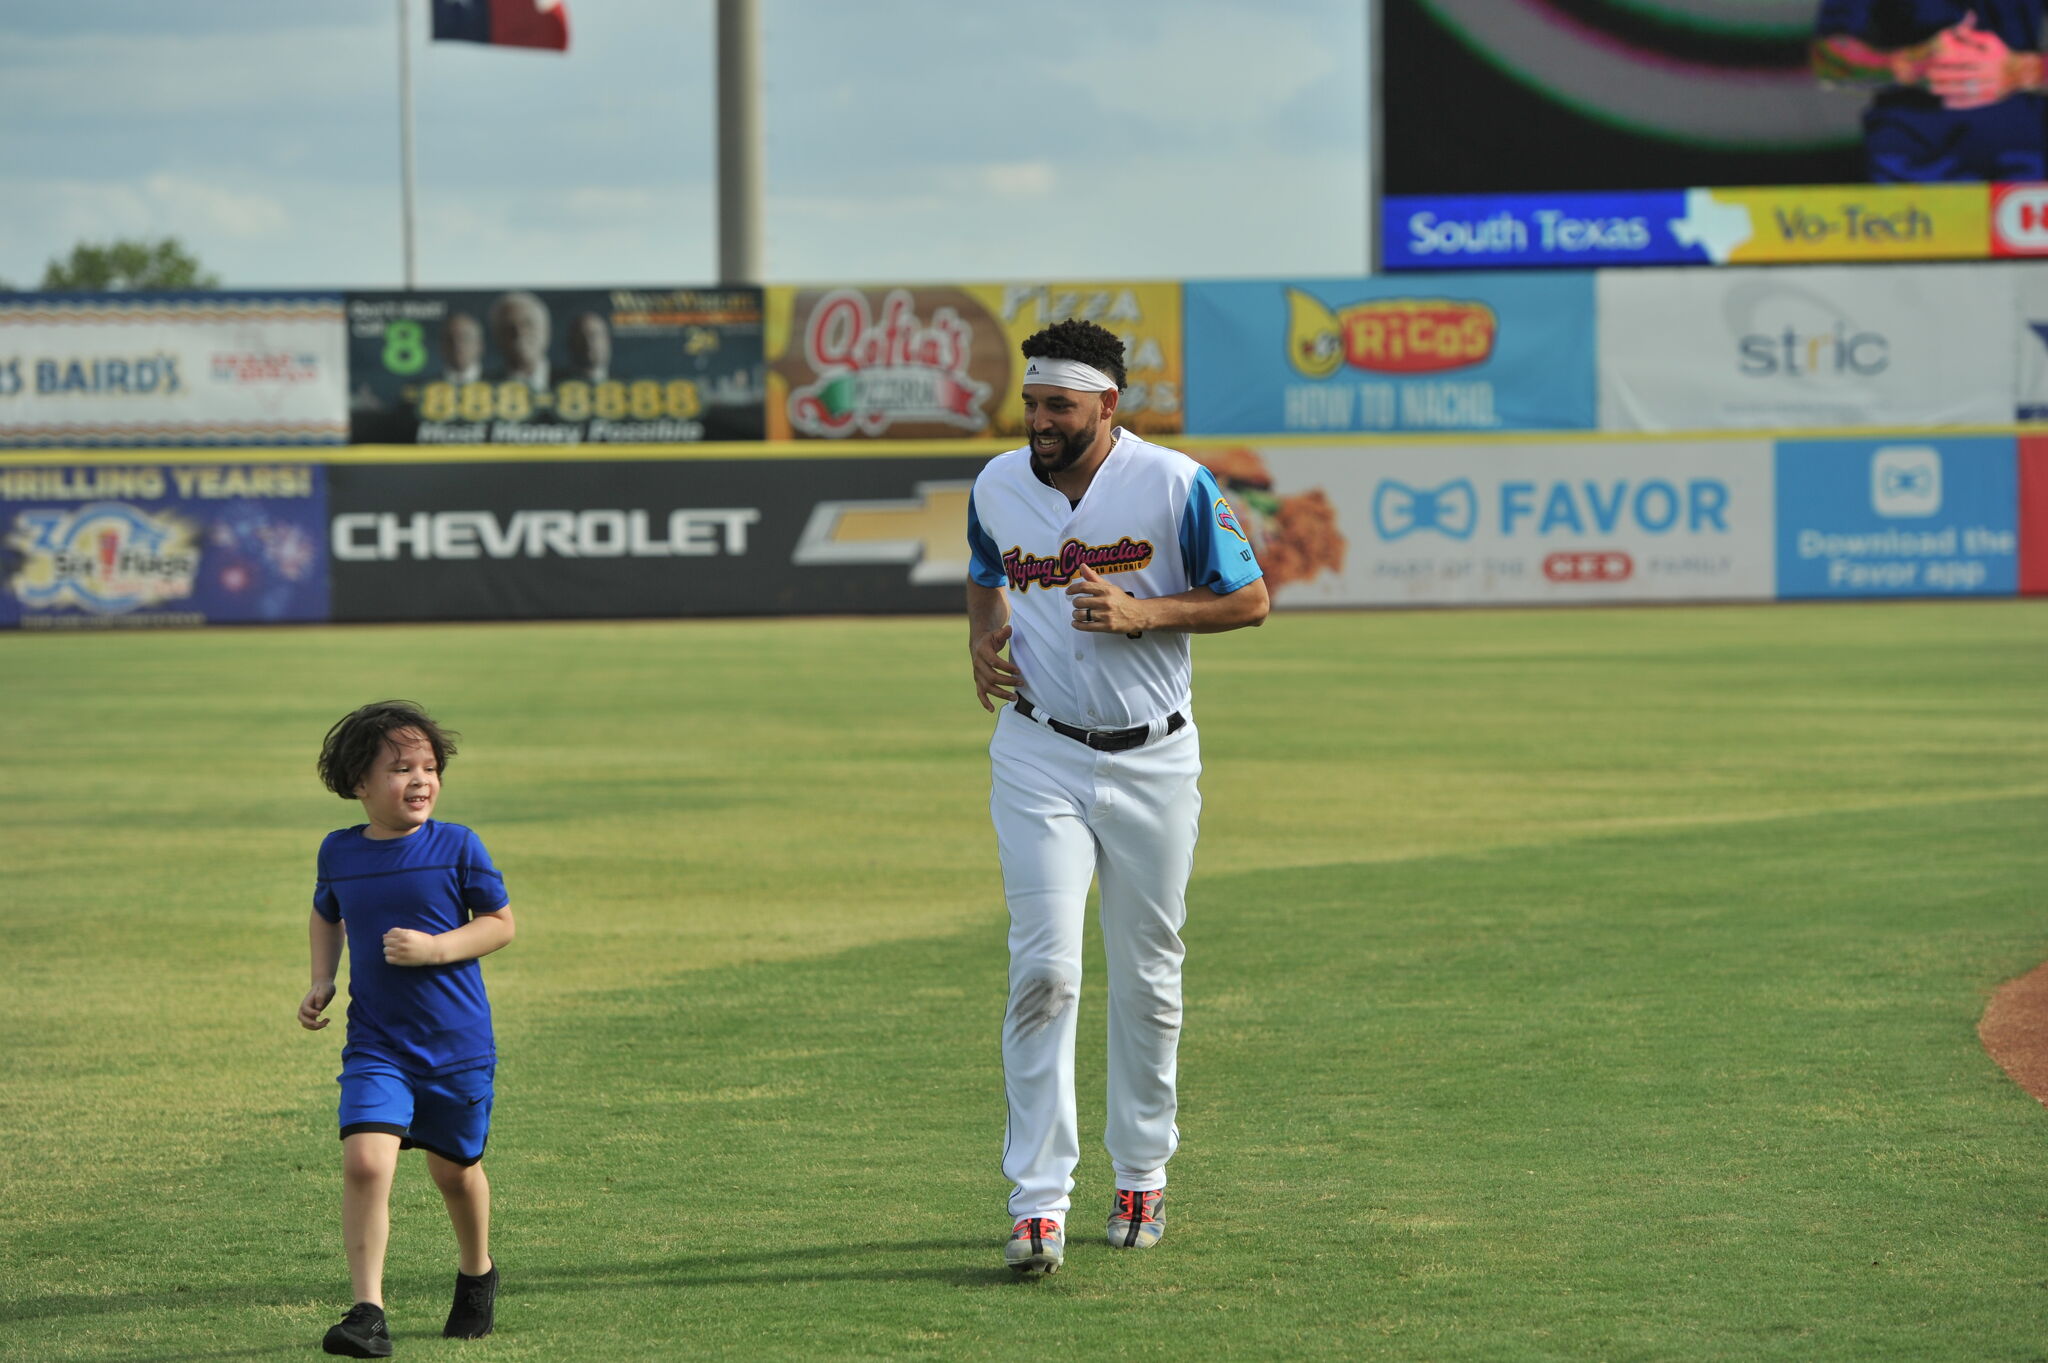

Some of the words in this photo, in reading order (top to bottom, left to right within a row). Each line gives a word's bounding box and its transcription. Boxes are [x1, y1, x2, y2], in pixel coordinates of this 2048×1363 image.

[1408, 210, 1528, 254] South
[1531, 208, 1650, 252] Texas
[1773, 202, 1934, 244] Vo-Tech
[382, 320, 429, 376] 8
[1737, 321, 1890, 378] stric
[35, 353, 183, 395] BAIRD'S
[420, 378, 703, 421] 888-8888
[1283, 383, 1355, 430] HOW
[1358, 382, 1396, 428] TO
[173, 466, 312, 498] YEARS!
[1499, 478, 1731, 535] FAVOR
[332, 508, 761, 561] CHEVROLET
[1798, 524, 1957, 558] Download
[1962, 525, 2016, 555] the
[1002, 546, 1070, 593] Flying
[1061, 538, 1156, 577] Chanclas
[1828, 558, 1917, 588] Favor
[1924, 560, 1987, 591] app
